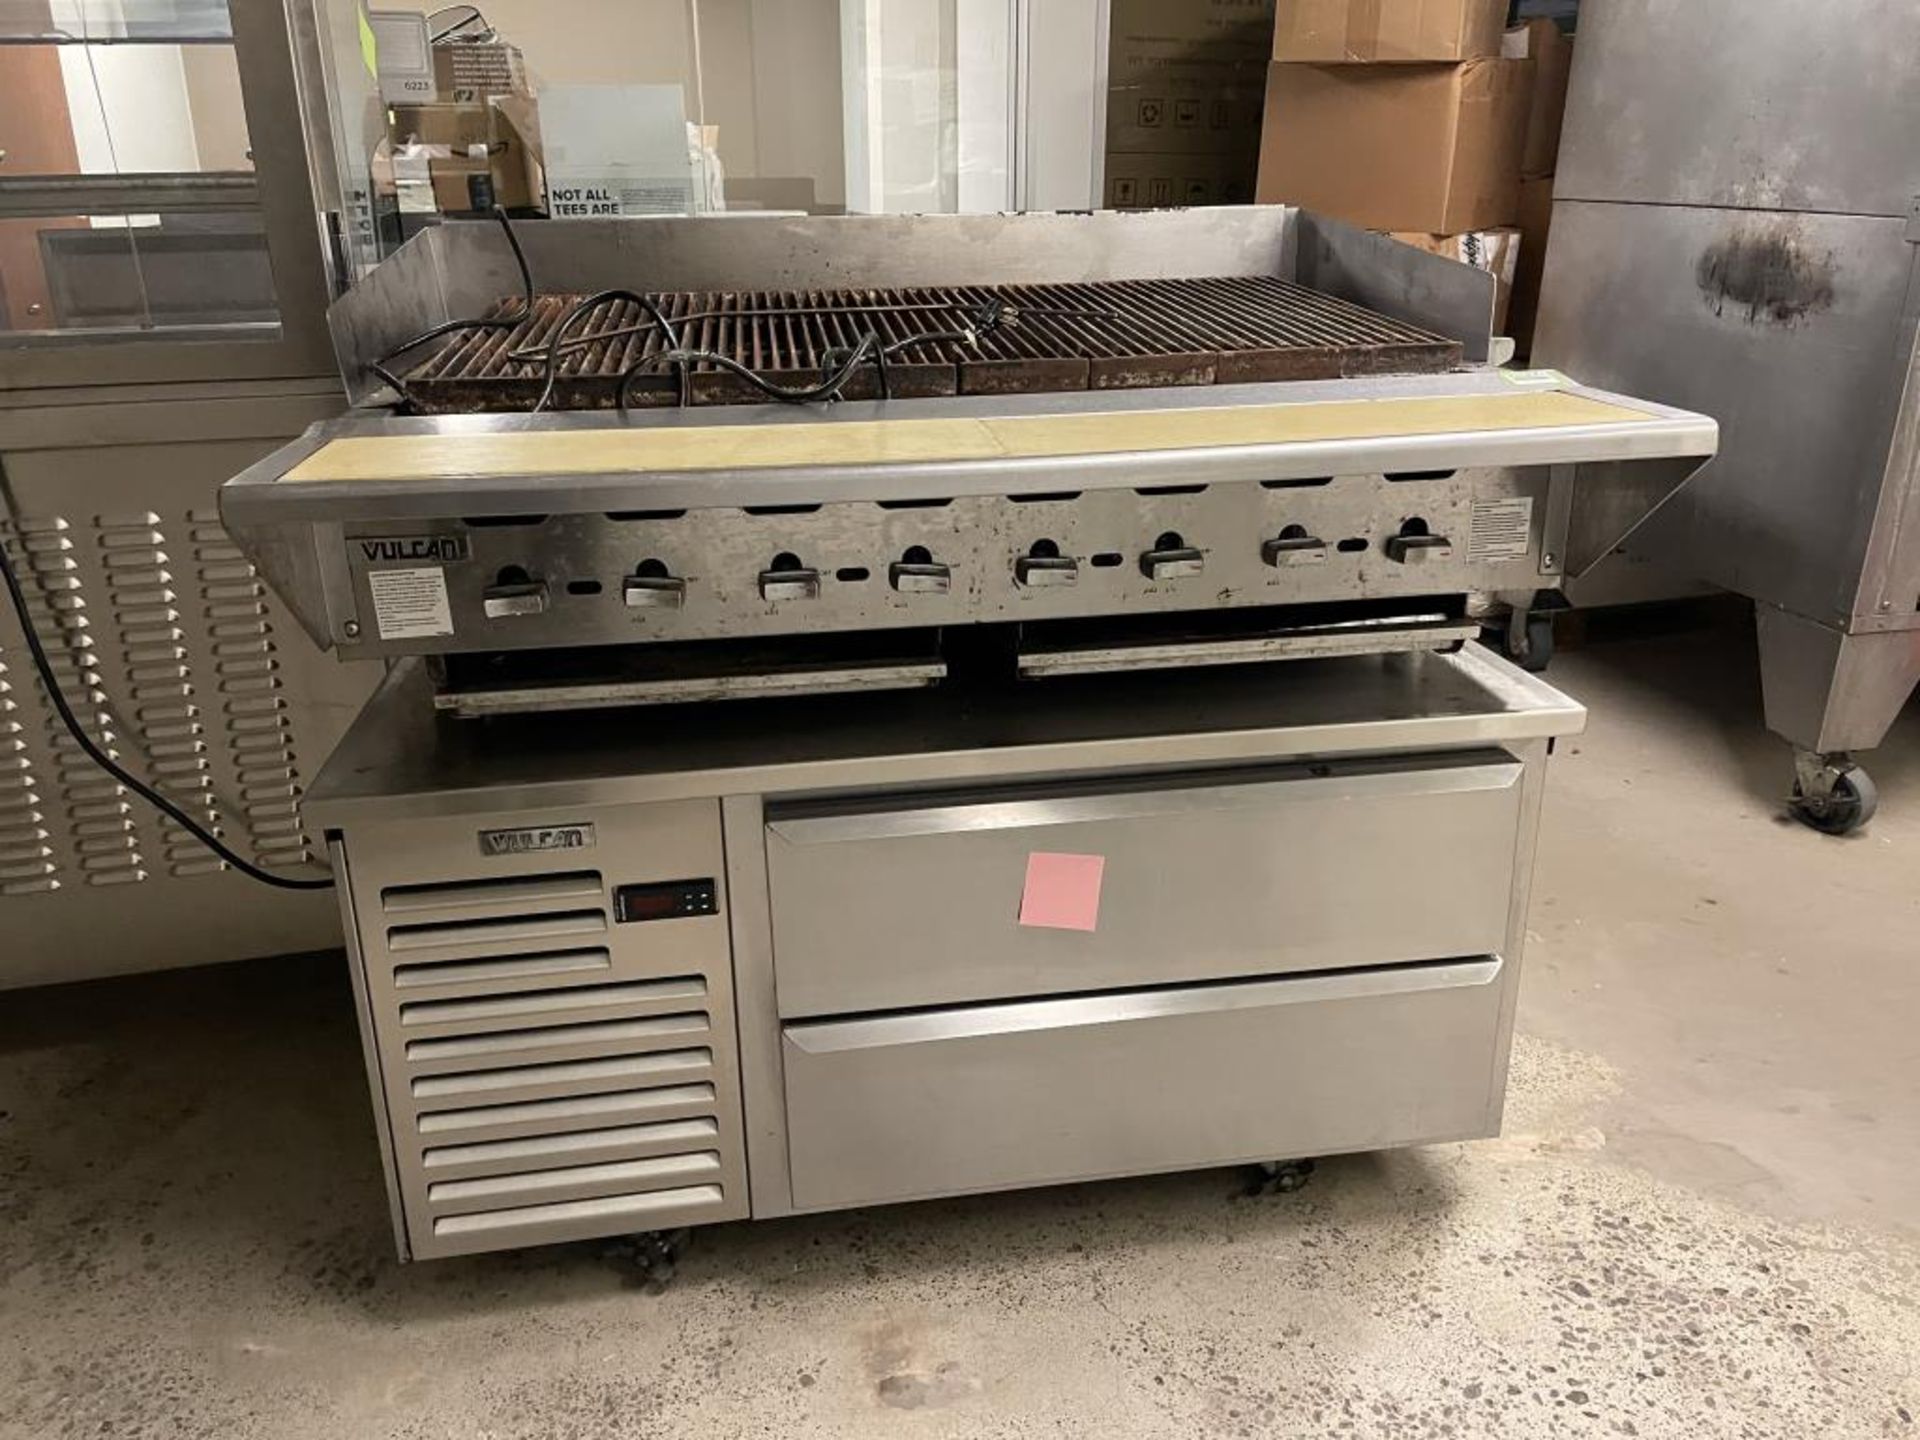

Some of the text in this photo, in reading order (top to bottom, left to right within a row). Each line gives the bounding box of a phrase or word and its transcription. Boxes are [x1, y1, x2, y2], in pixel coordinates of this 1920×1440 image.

[552, 189, 582, 201] NOT
[585, 189, 612, 201] ALL
[554, 203, 620, 215] TEES ARE
[361, 539, 459, 561] VULCAN
